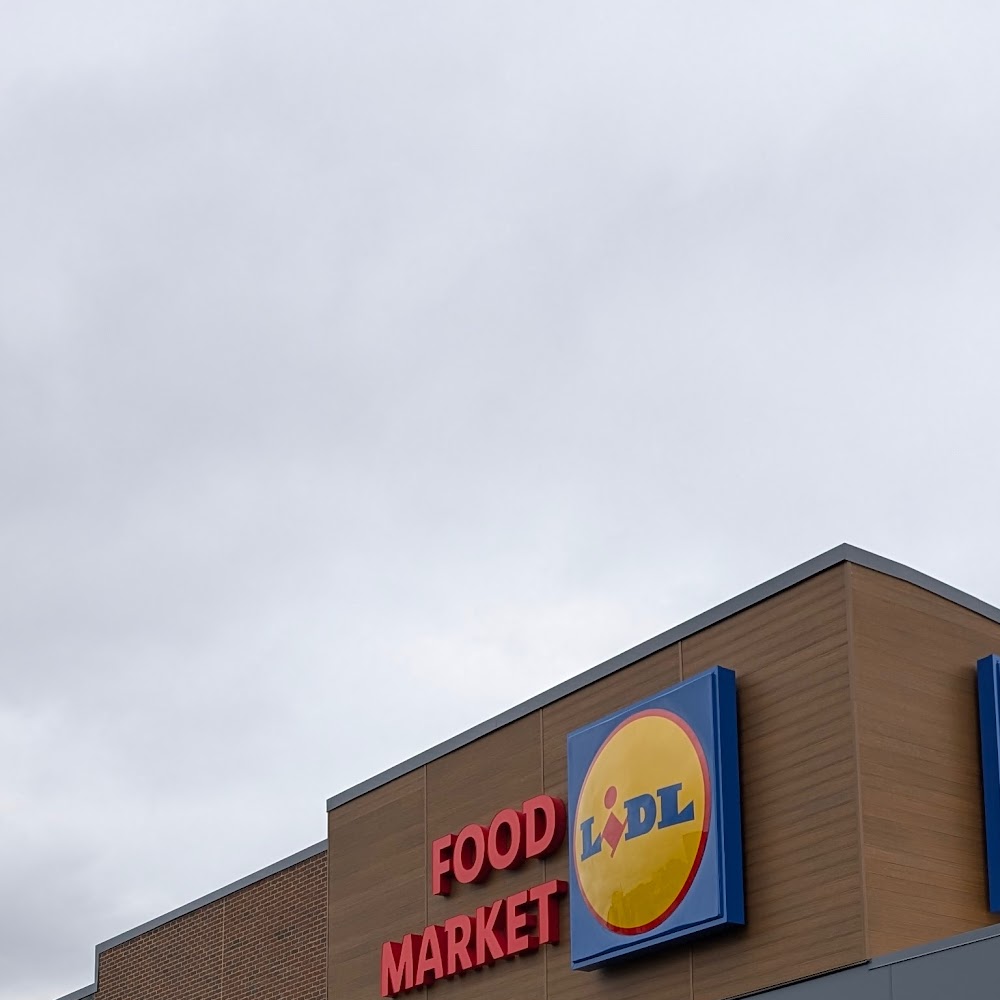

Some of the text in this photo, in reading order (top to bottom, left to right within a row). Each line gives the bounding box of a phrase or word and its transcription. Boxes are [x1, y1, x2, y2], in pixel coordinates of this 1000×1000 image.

[432, 794, 566, 896] FOOD
[580, 782, 695, 862] LIDL
[381, 880, 569, 998] MARKET
